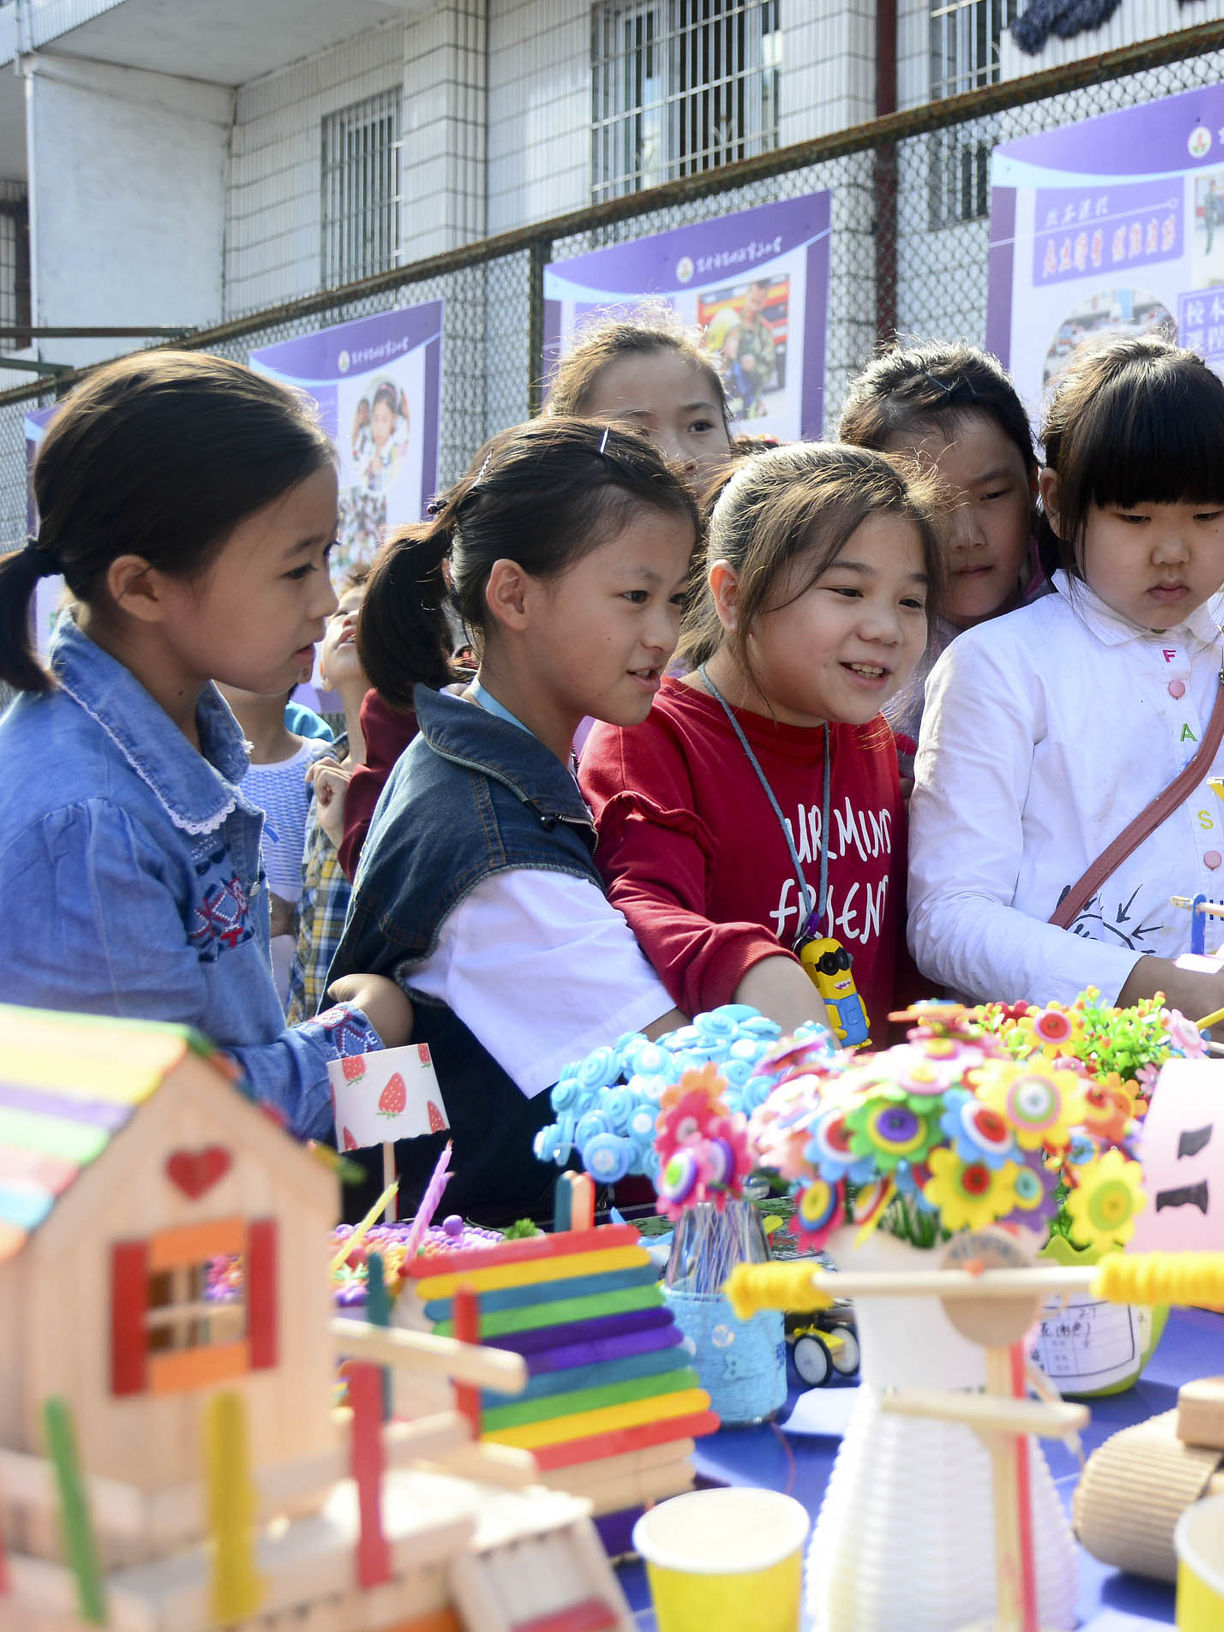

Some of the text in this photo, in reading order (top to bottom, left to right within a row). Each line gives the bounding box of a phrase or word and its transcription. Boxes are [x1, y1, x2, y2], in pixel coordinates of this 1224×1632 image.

[1163, 649, 1177, 663] F
[1180, 723, 1198, 742] A
[1198, 810, 1214, 830] S
[769, 874, 889, 944] FRIEN
